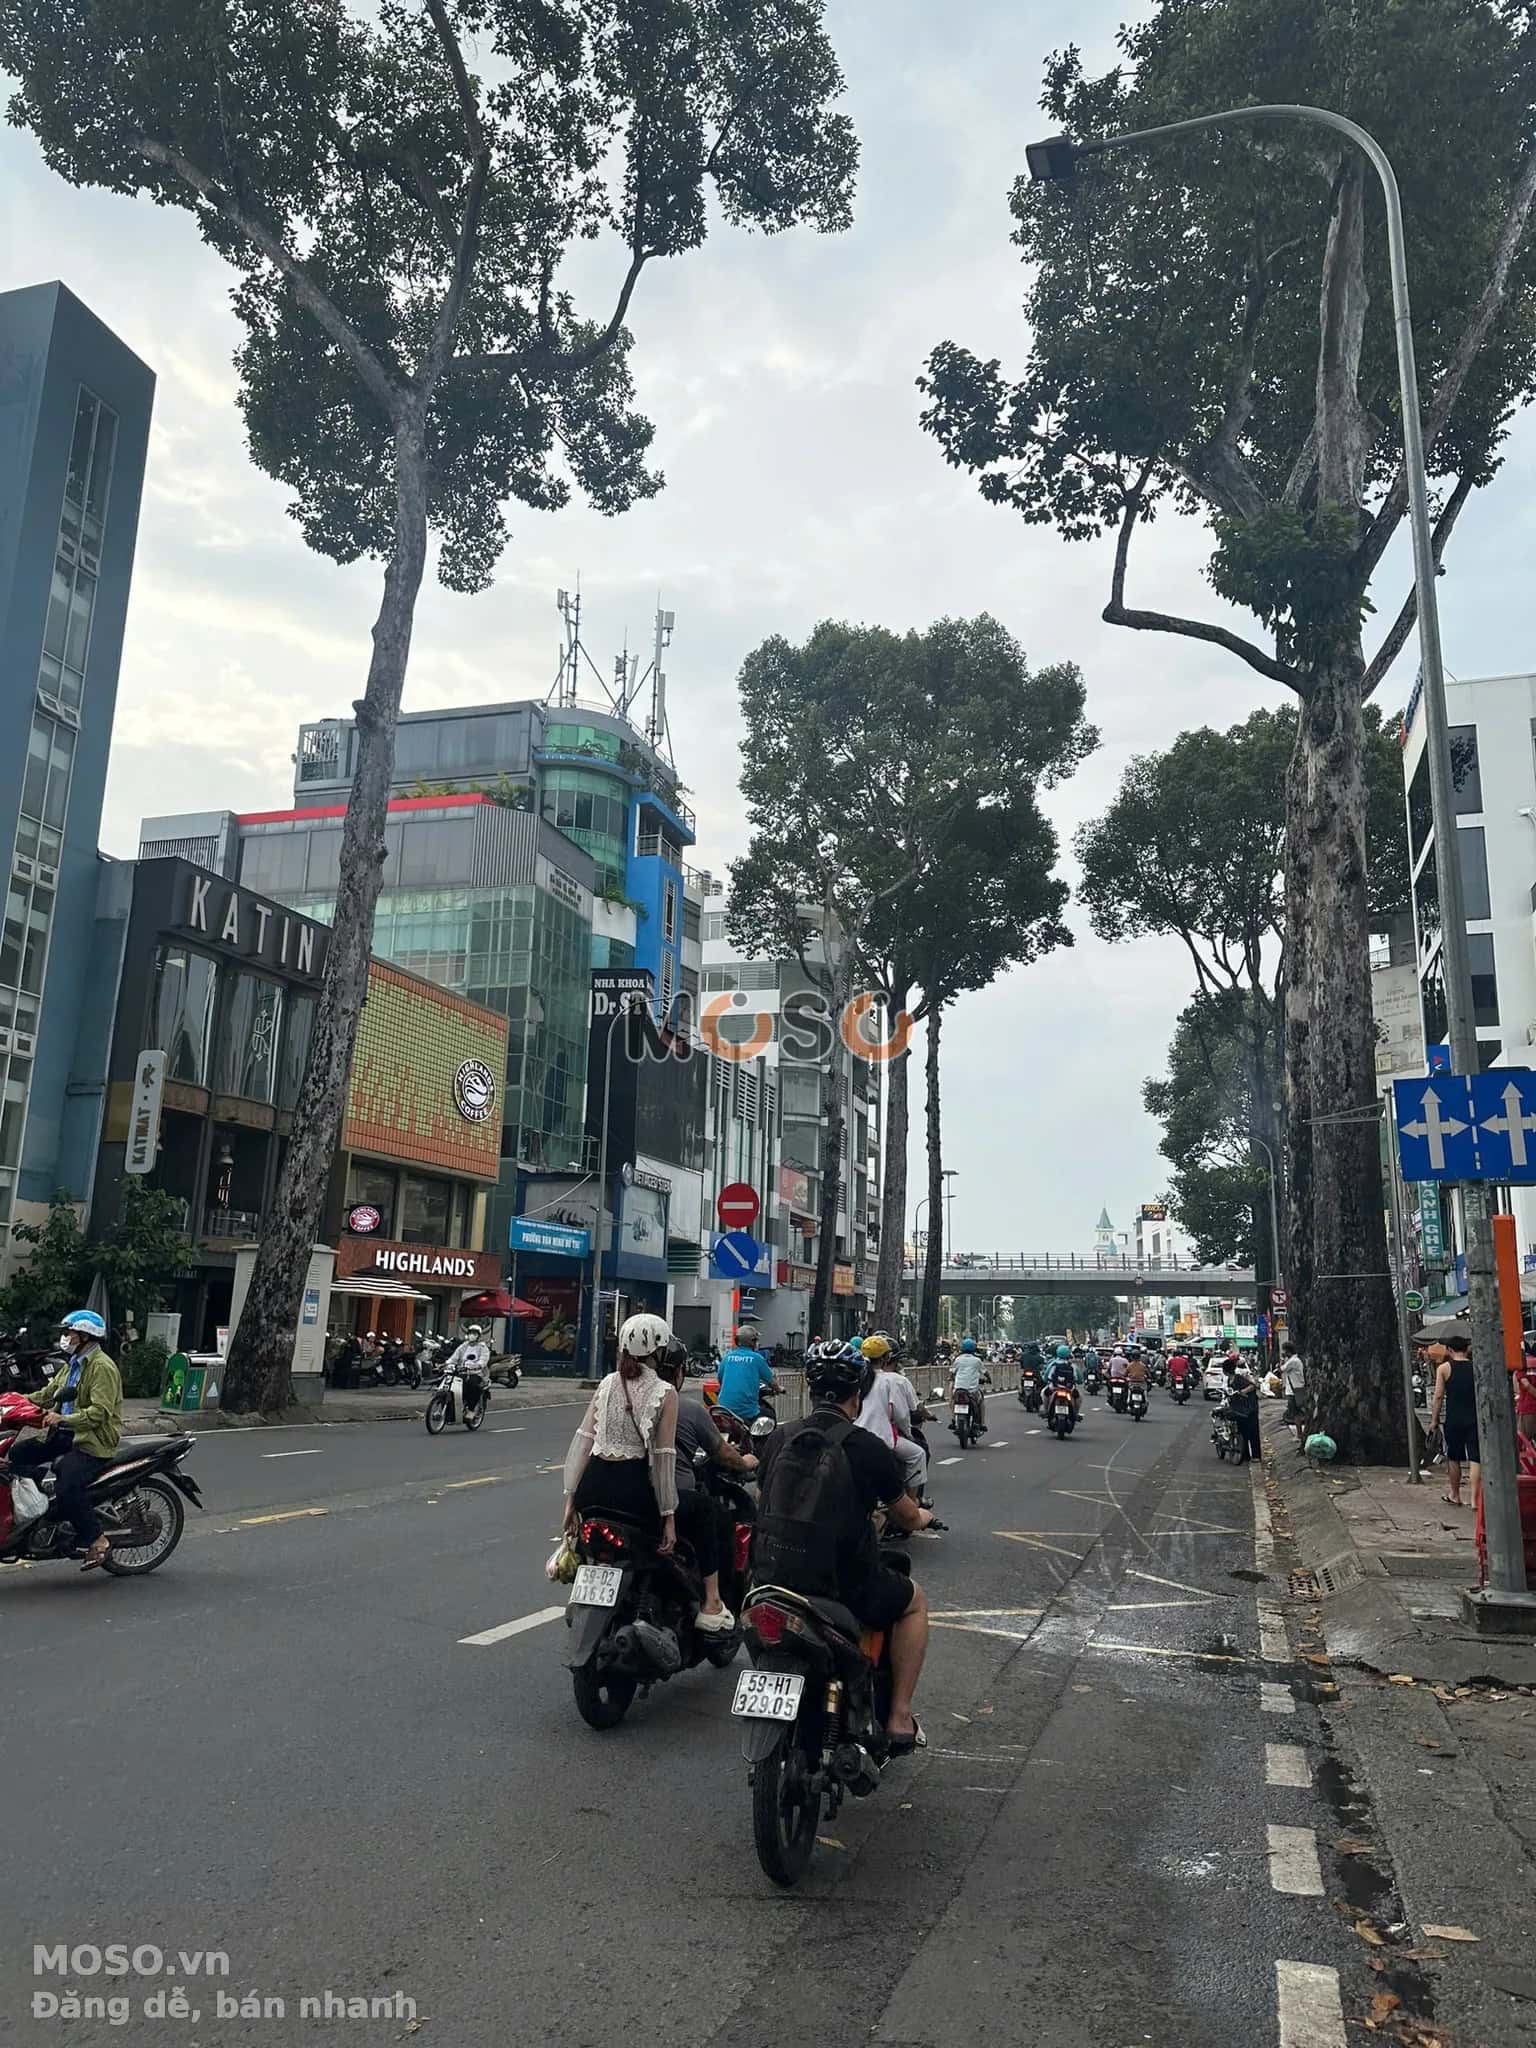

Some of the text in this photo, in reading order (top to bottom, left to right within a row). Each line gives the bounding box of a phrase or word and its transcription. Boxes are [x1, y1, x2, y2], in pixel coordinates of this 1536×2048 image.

[190, 875, 332, 978] KATIN
[594, 978, 645, 989] NHA KHOA
[457, 1062, 494, 1091] HIGHLANDS
[460, 1100, 489, 1120] COFFEE
[375, 1249, 475, 1277] HIGHLANDS
[747, 1674, 792, 1695] 59-H1
[736, 1694, 795, 1716] 329.05
